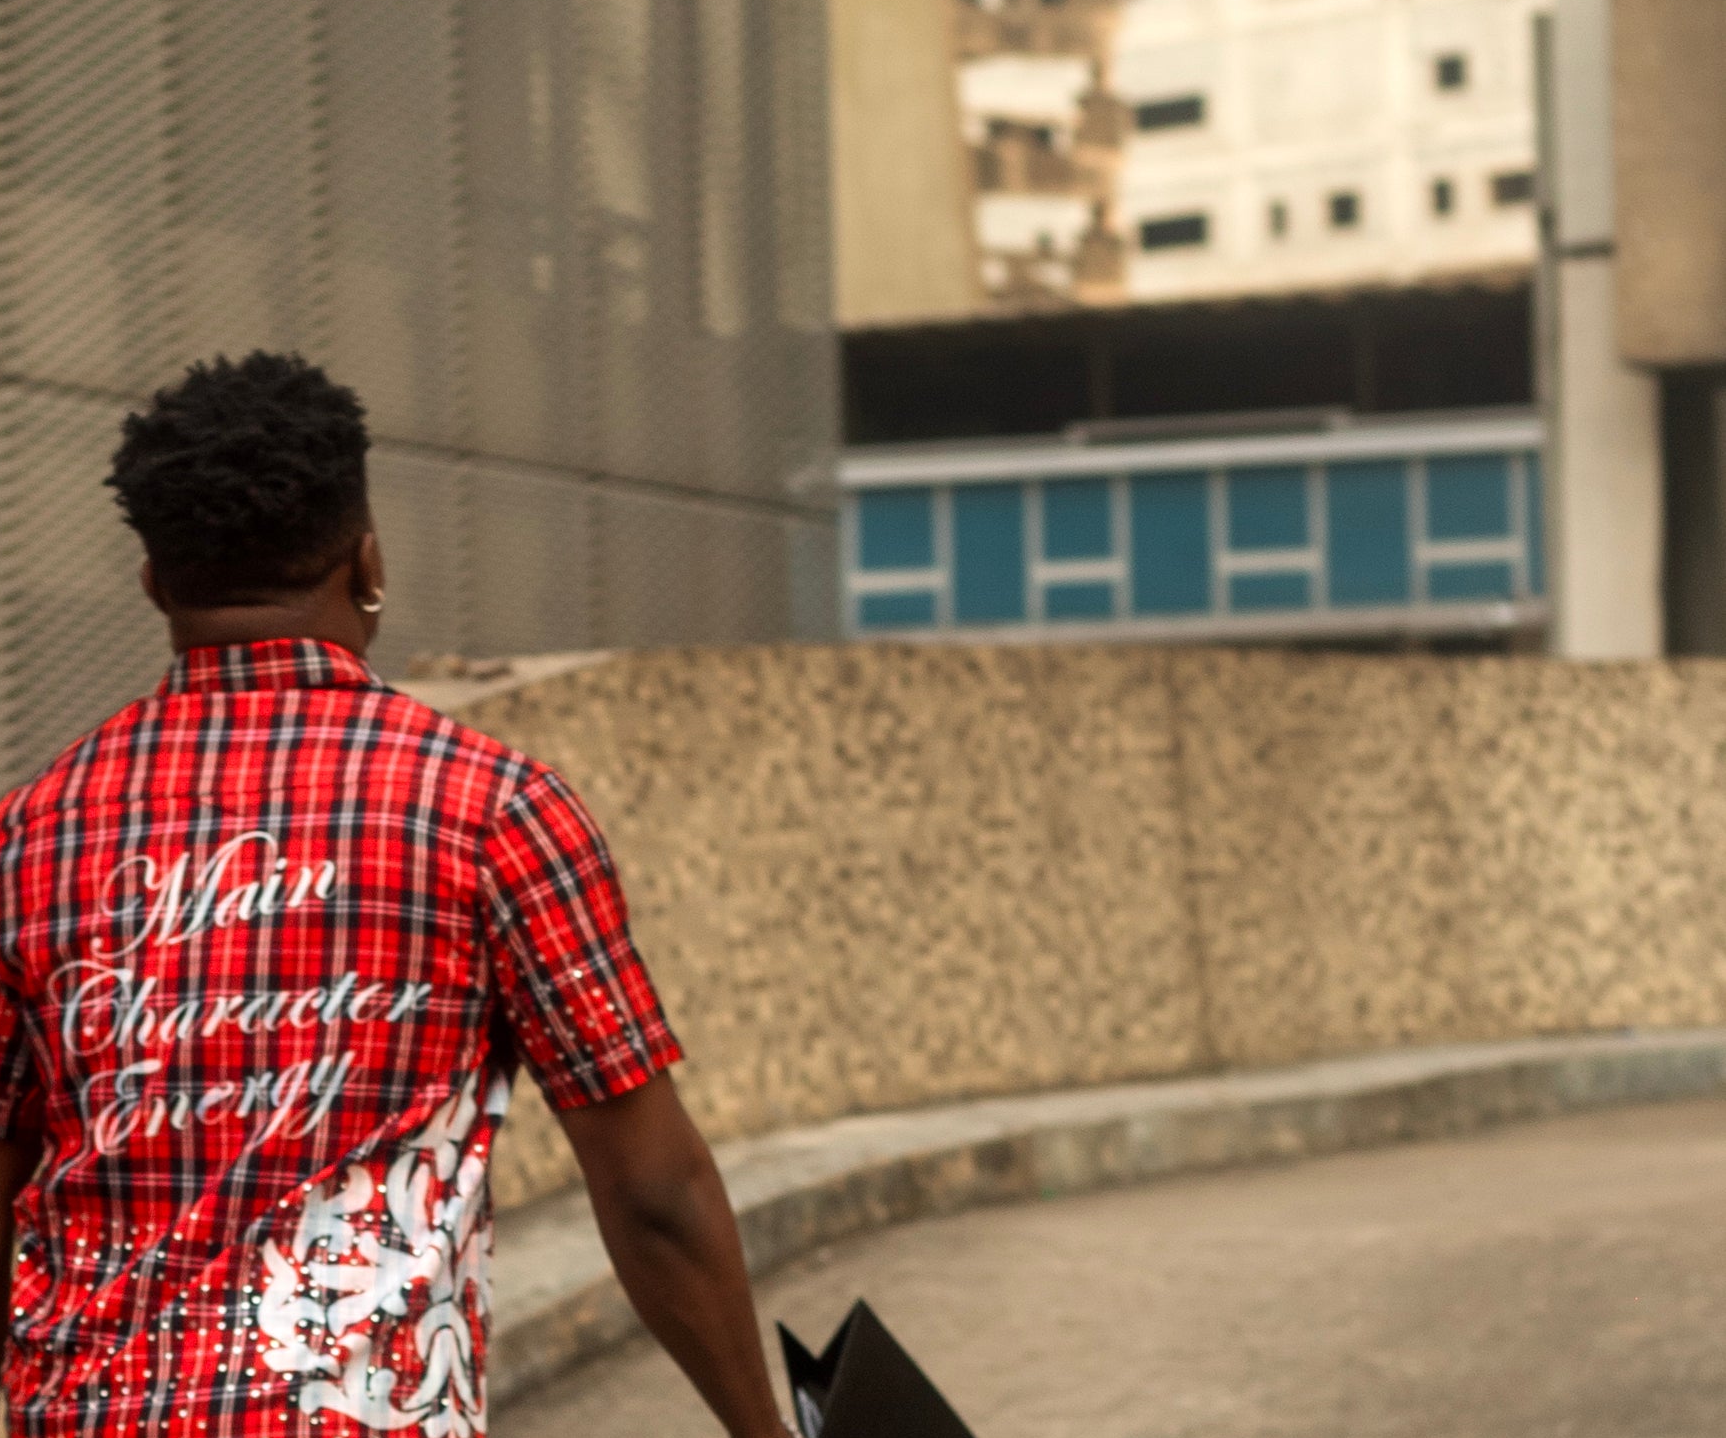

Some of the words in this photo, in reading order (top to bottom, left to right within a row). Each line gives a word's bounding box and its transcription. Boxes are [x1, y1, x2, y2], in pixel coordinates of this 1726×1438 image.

[89, 829, 336, 961] Main
[47, 958, 432, 1058] Character
[80, 1049, 356, 1156] Energy
